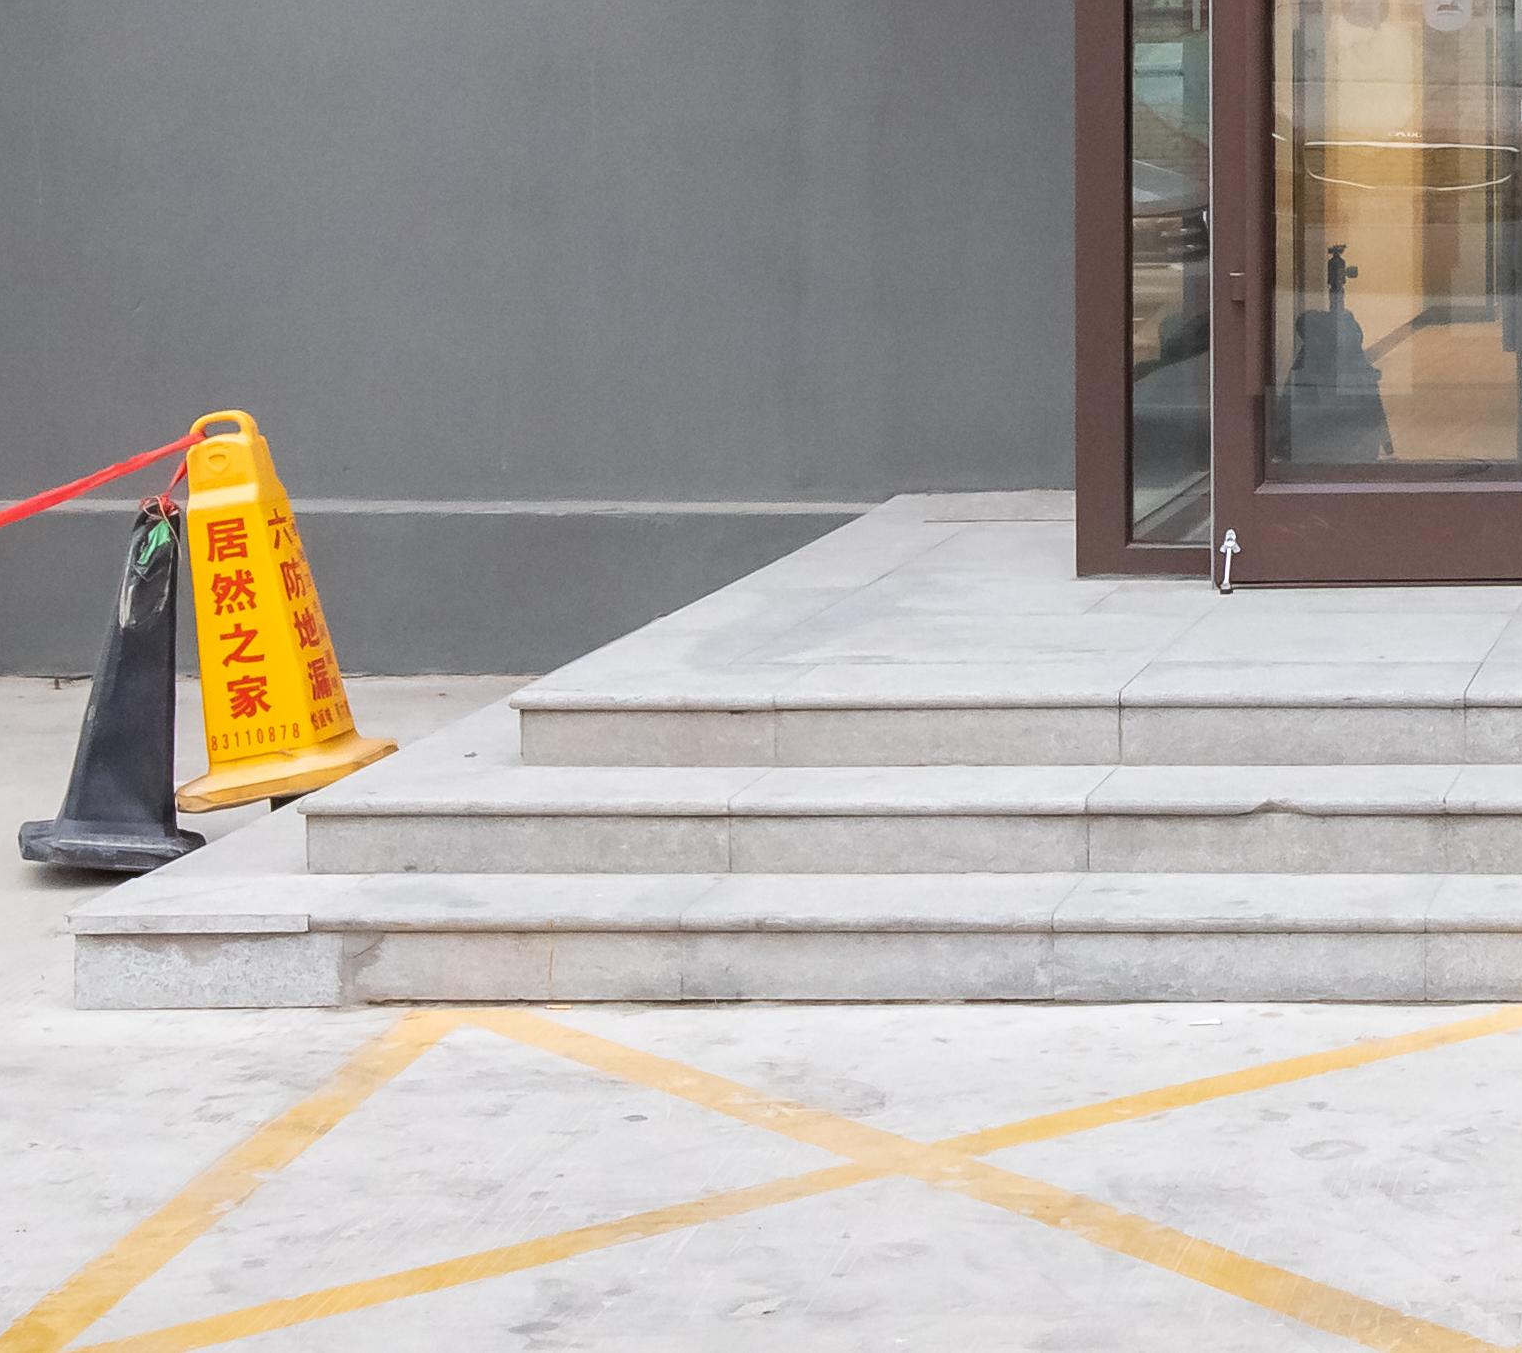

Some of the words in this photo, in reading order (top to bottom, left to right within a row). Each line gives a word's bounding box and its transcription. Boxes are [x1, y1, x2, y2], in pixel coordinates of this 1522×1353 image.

[206, 517, 273, 720] 居然之家
[267, 508, 333, 701] 六防地漏
[210, 722, 301, 752] 83110878
